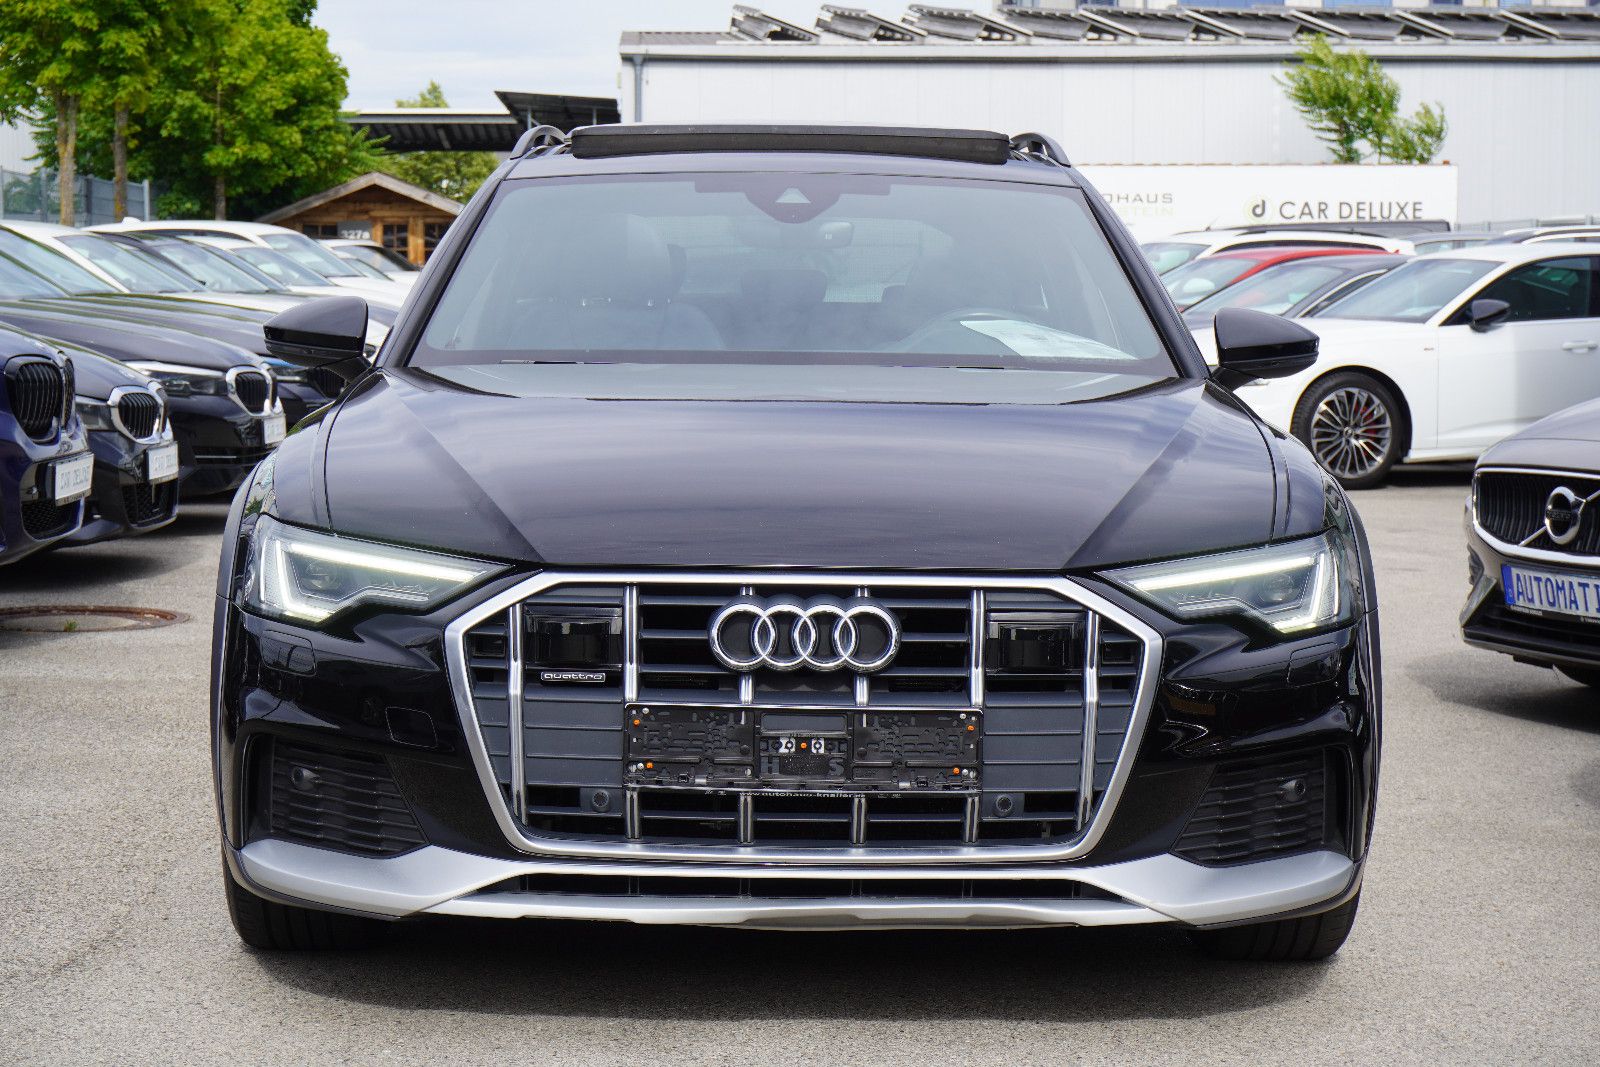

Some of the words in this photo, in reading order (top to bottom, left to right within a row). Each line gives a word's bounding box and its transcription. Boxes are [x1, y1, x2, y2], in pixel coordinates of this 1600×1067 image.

[1279, 201, 1329, 220] CAR
[1339, 201, 1424, 220] DELUXE
[543, 673, 603, 681] quattro
